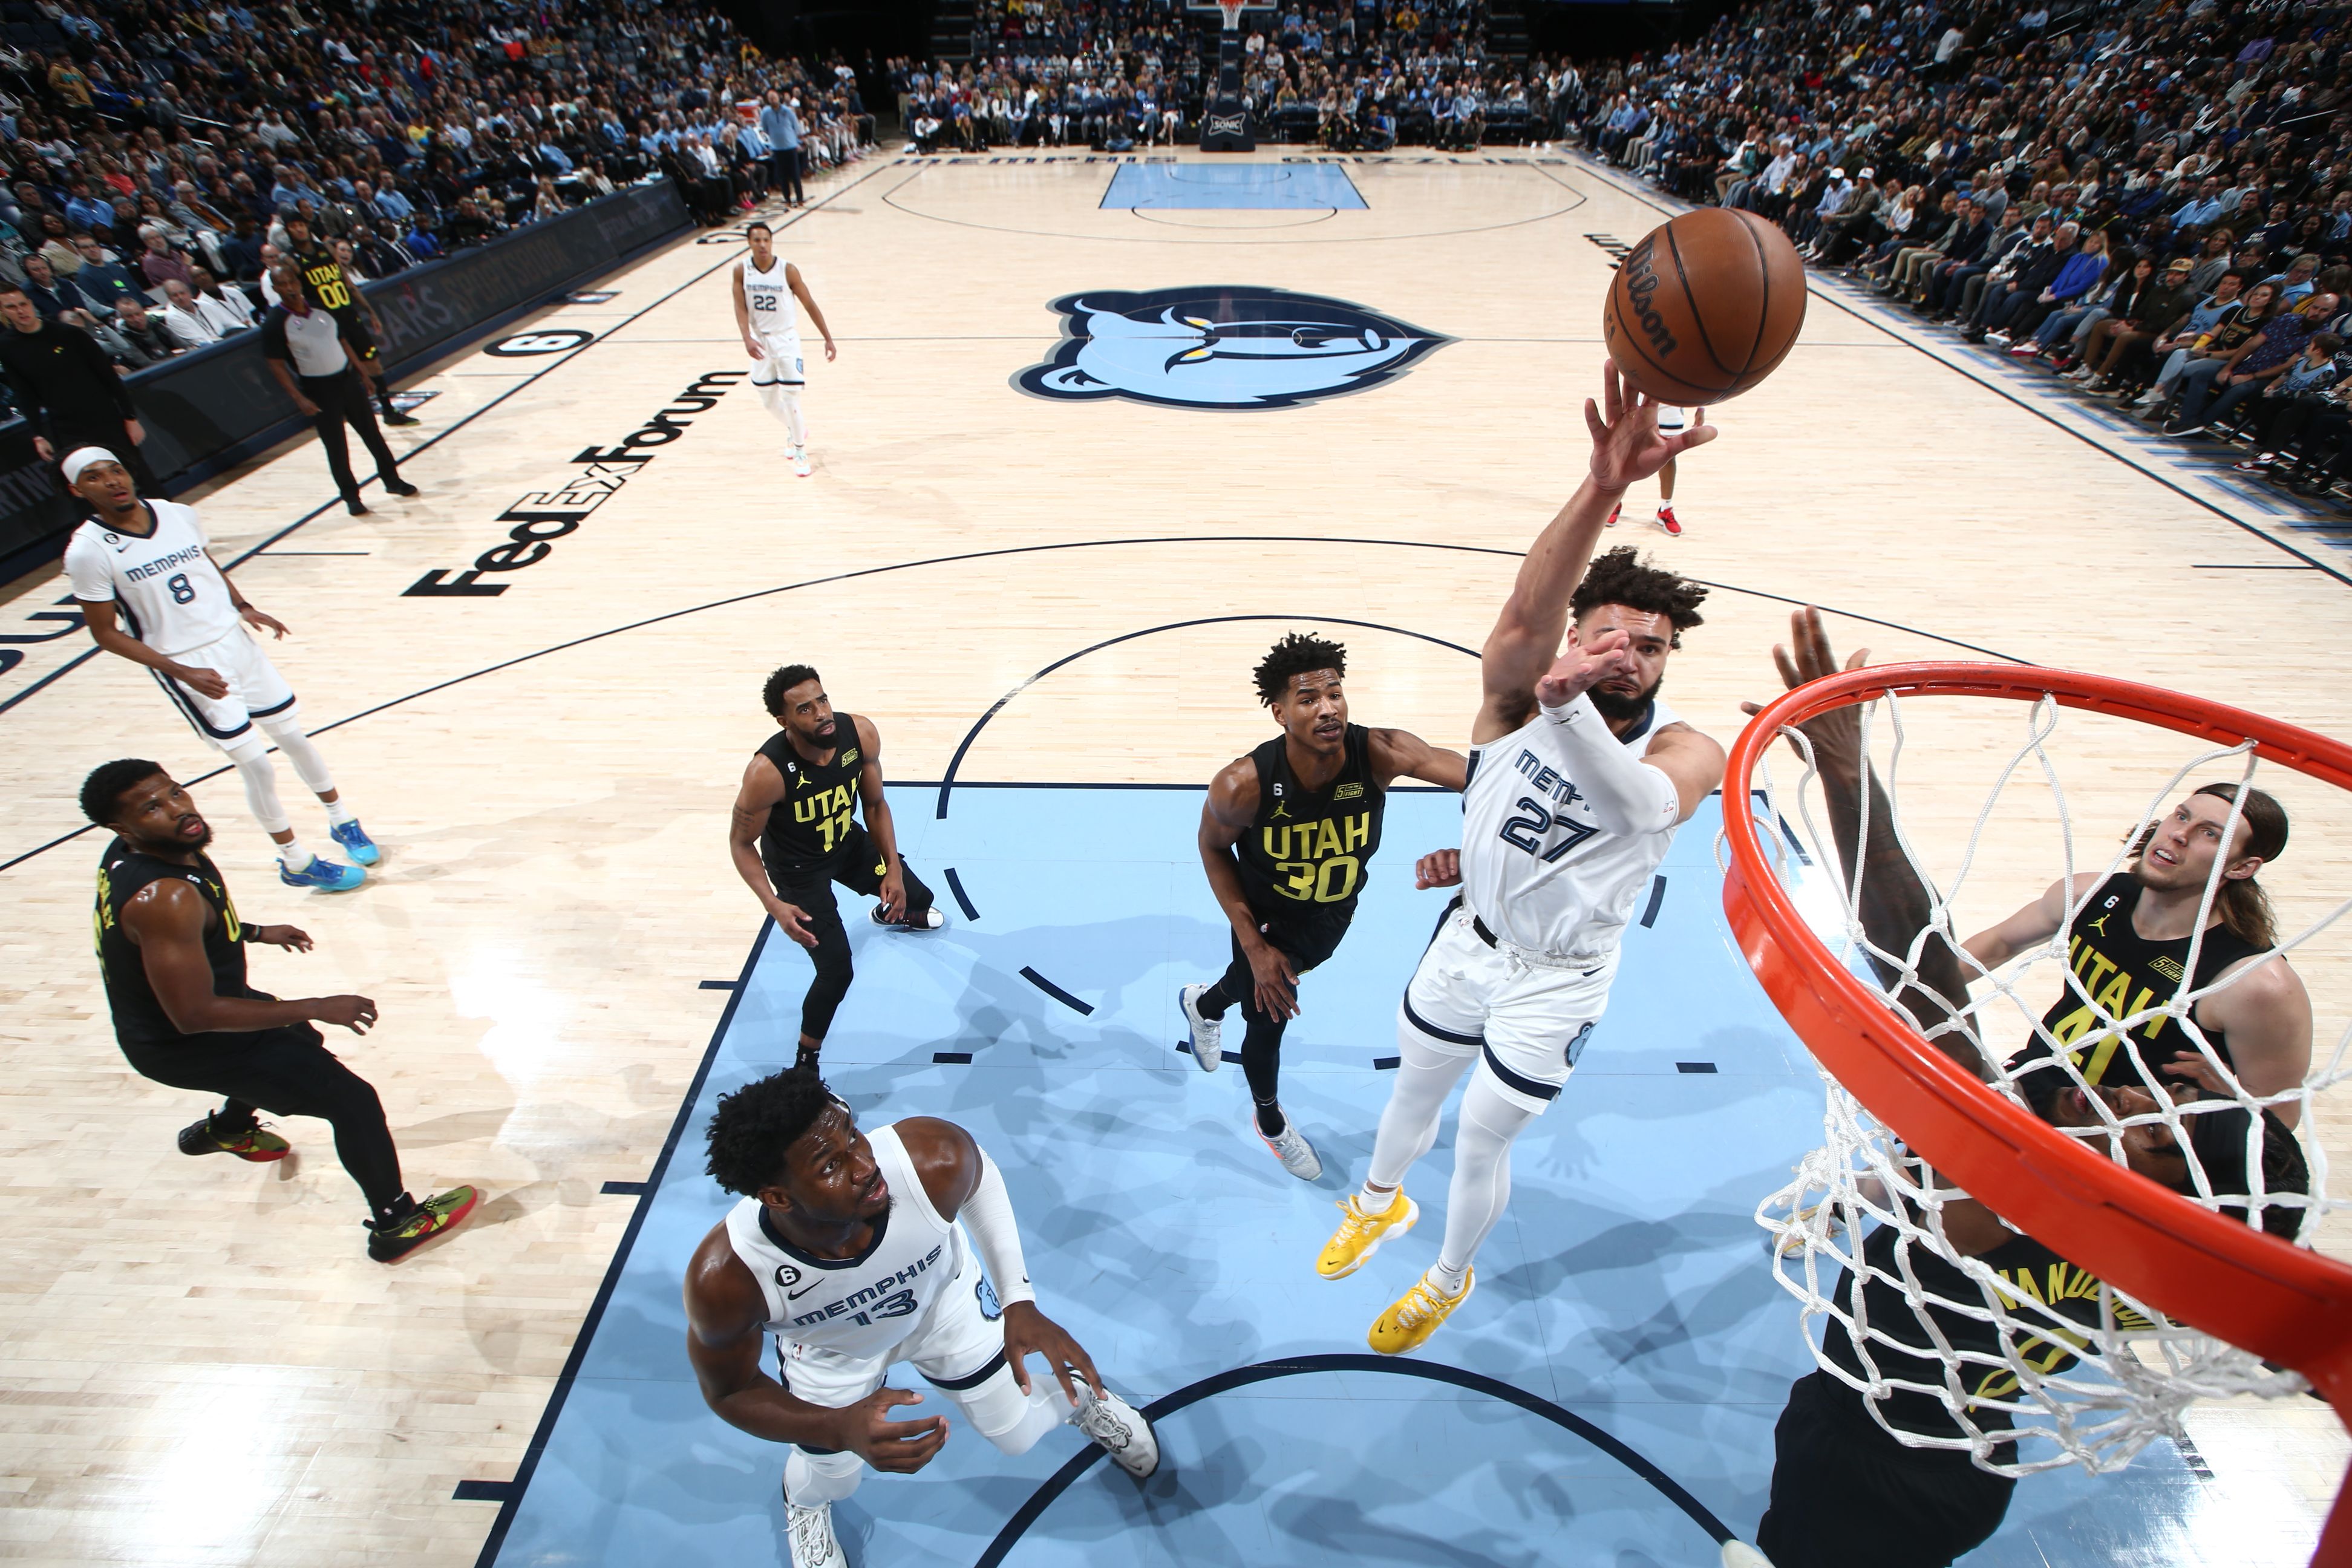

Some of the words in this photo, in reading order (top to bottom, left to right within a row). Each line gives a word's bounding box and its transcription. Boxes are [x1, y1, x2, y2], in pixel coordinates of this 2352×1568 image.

[1214, 120, 1240, 130] SONIC
[892, 156, 1177, 165] MEMPHIS
[1282, 156, 1567, 165] GRIZZLIES
[305, 263, 342, 286] UTAH
[318, 280, 351, 310] 00
[746, 284, 783, 292] MEMPHIS
[1626, 234, 1678, 359] Wilson
[754, 295, 777, 311] 22
[497, 334, 583, 352] 6
[399, 371, 750, 597] FedExForum
[125, 544, 201, 583] MEMPHIS
[168, 573, 195, 604] 8
[787, 762, 797, 773] 6
[1273, 783, 1283, 796] 6
[1336, 786, 1345, 799] 5
[815, 808, 852, 853] 11
[1264, 811, 1370, 860] UTAH
[1498, 796, 1601, 864] 27
[1272, 855, 1359, 903] 30
[2103, 895, 2120, 909] 6
[2153, 958, 2170, 968] 5
[2161, 967, 2183, 981] FIGHT
[2068, 933, 2170, 1040] UTAH
[2051, 1004, 2121, 1086] 41
[780, 1267, 797, 1284] 6
[792, 1244, 941, 1327] MEMPHIS
[845, 1288, 918, 1327] 13
